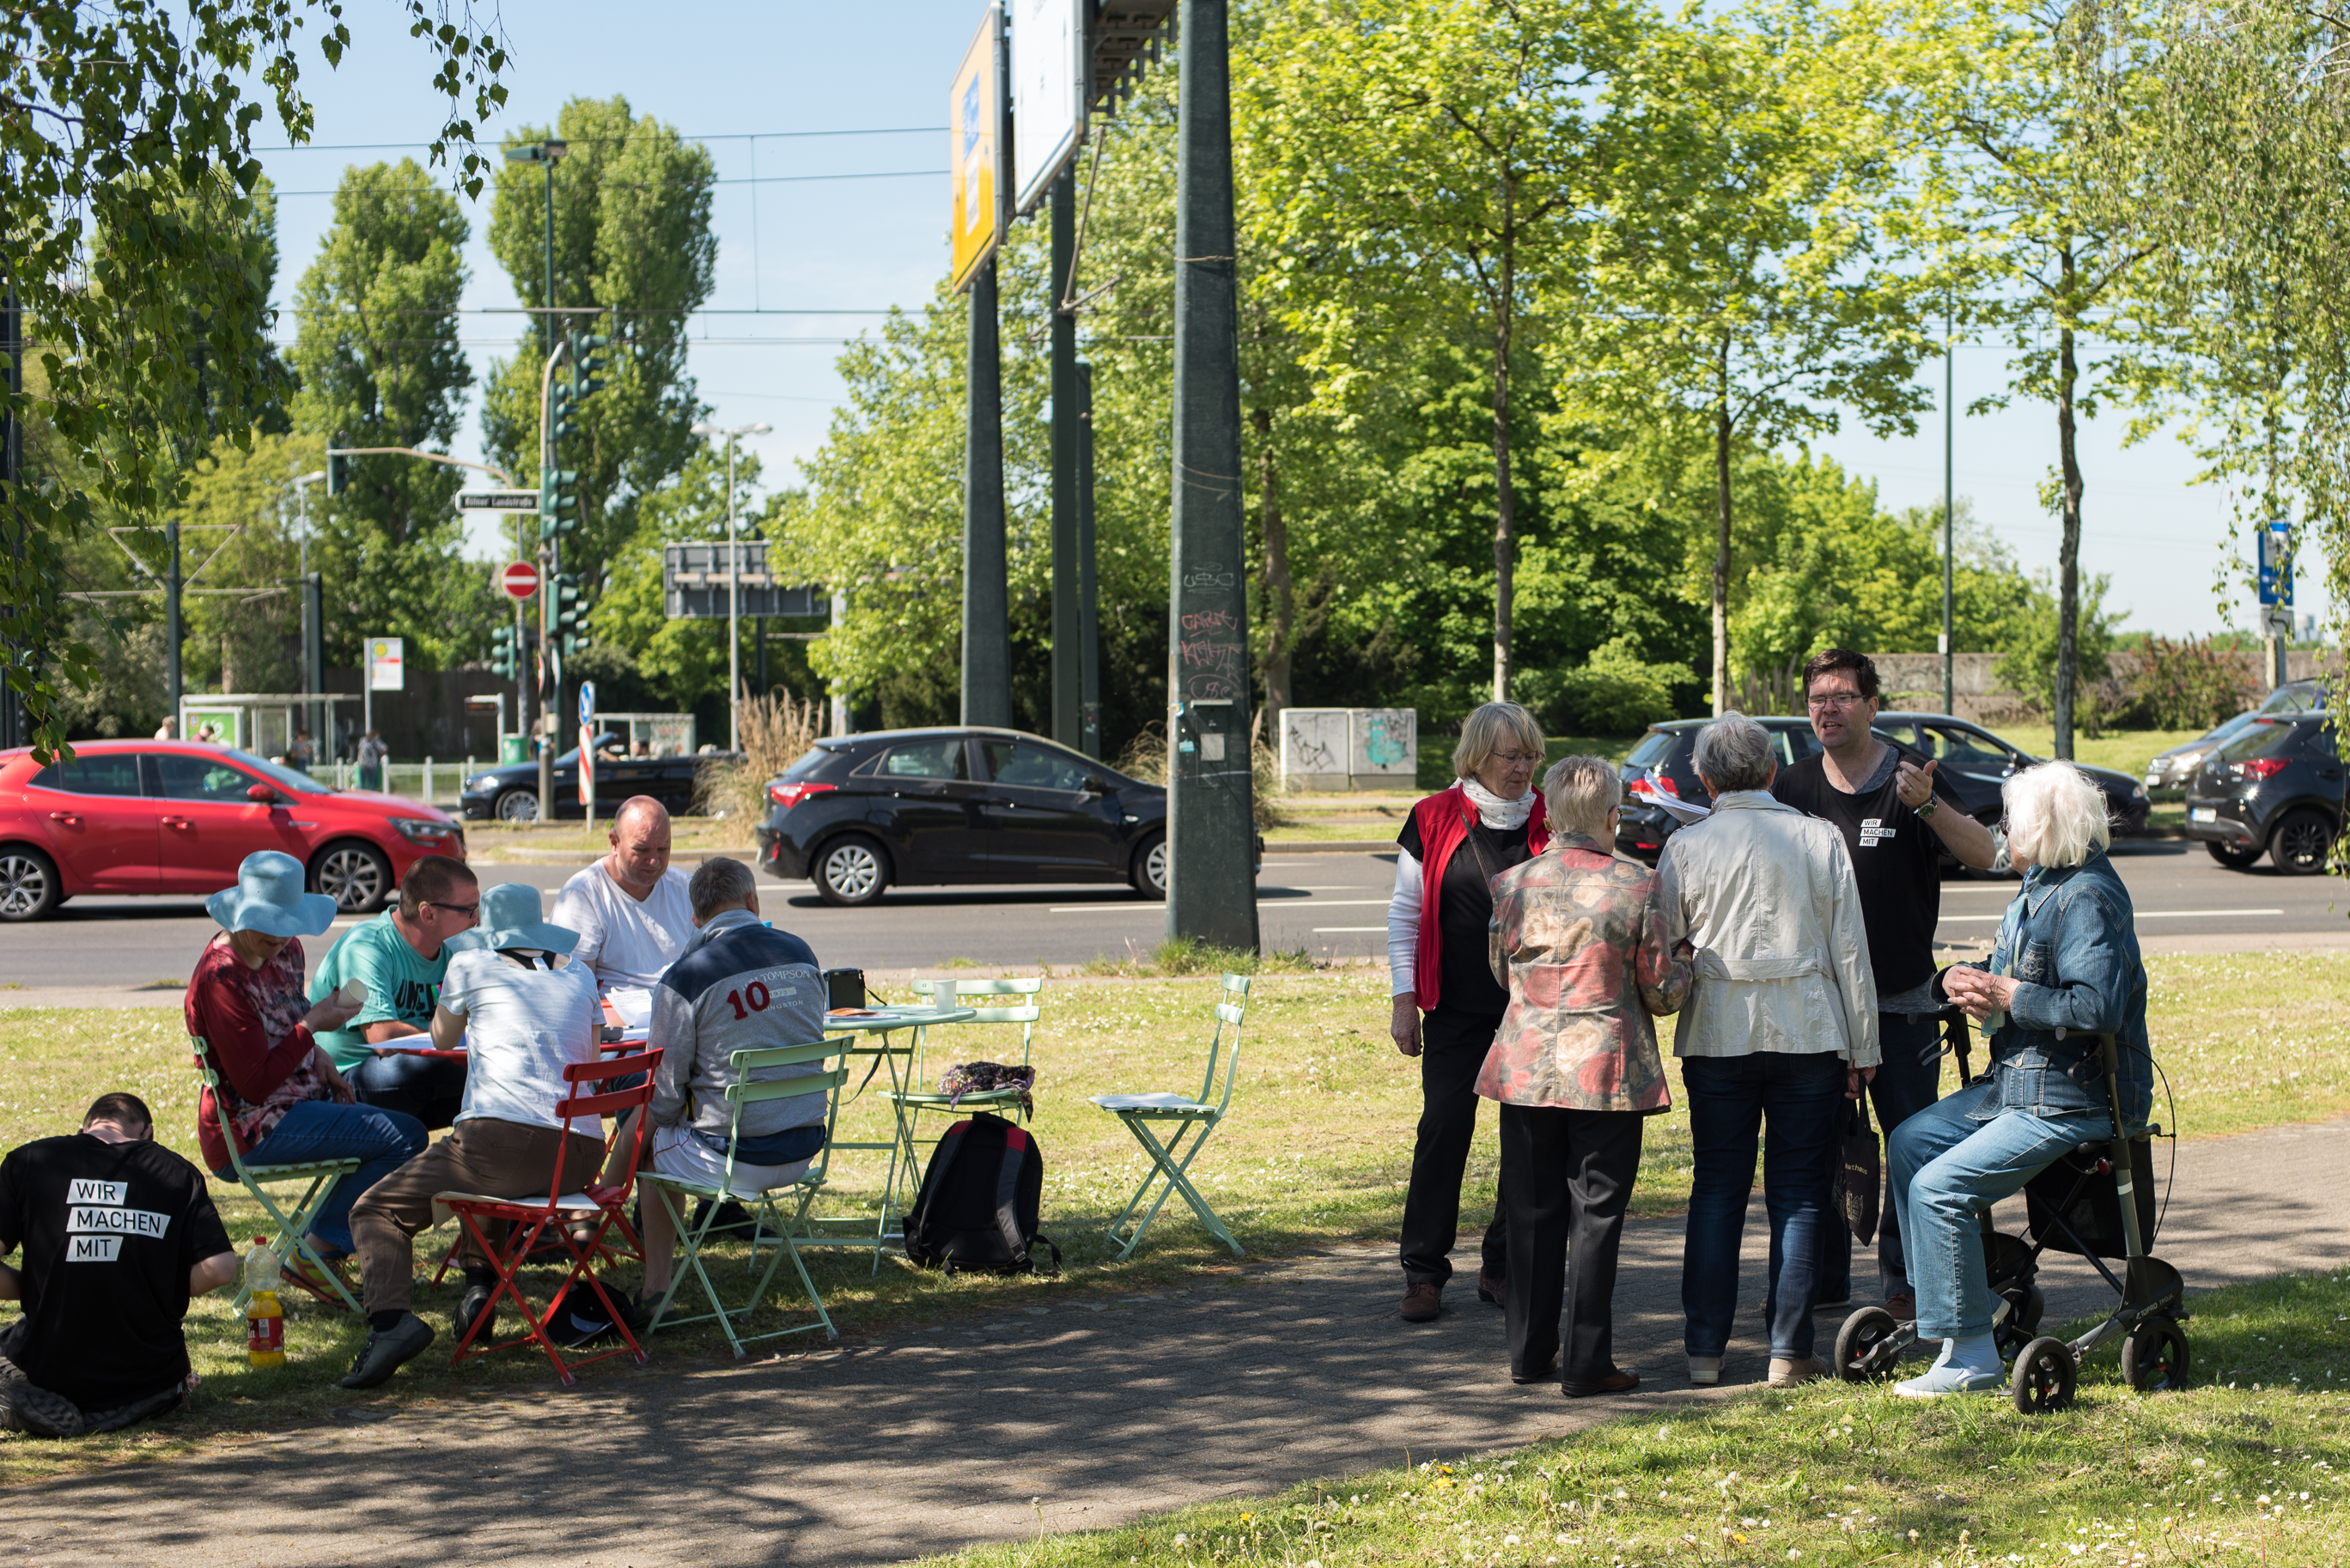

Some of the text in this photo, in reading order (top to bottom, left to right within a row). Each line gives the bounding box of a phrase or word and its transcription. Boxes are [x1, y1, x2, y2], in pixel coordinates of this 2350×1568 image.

[760, 969, 810, 982] TOMPSON
[395, 979, 443, 1012] UNCL
[727, 981, 770, 1020] 10
[76, 1182, 116, 1200] WIR
[76, 1210, 161, 1234] MACHEN
[76, 1239, 112, 1257] MIT
[2140, 1293, 2174, 1317] TOPRO TROJA
